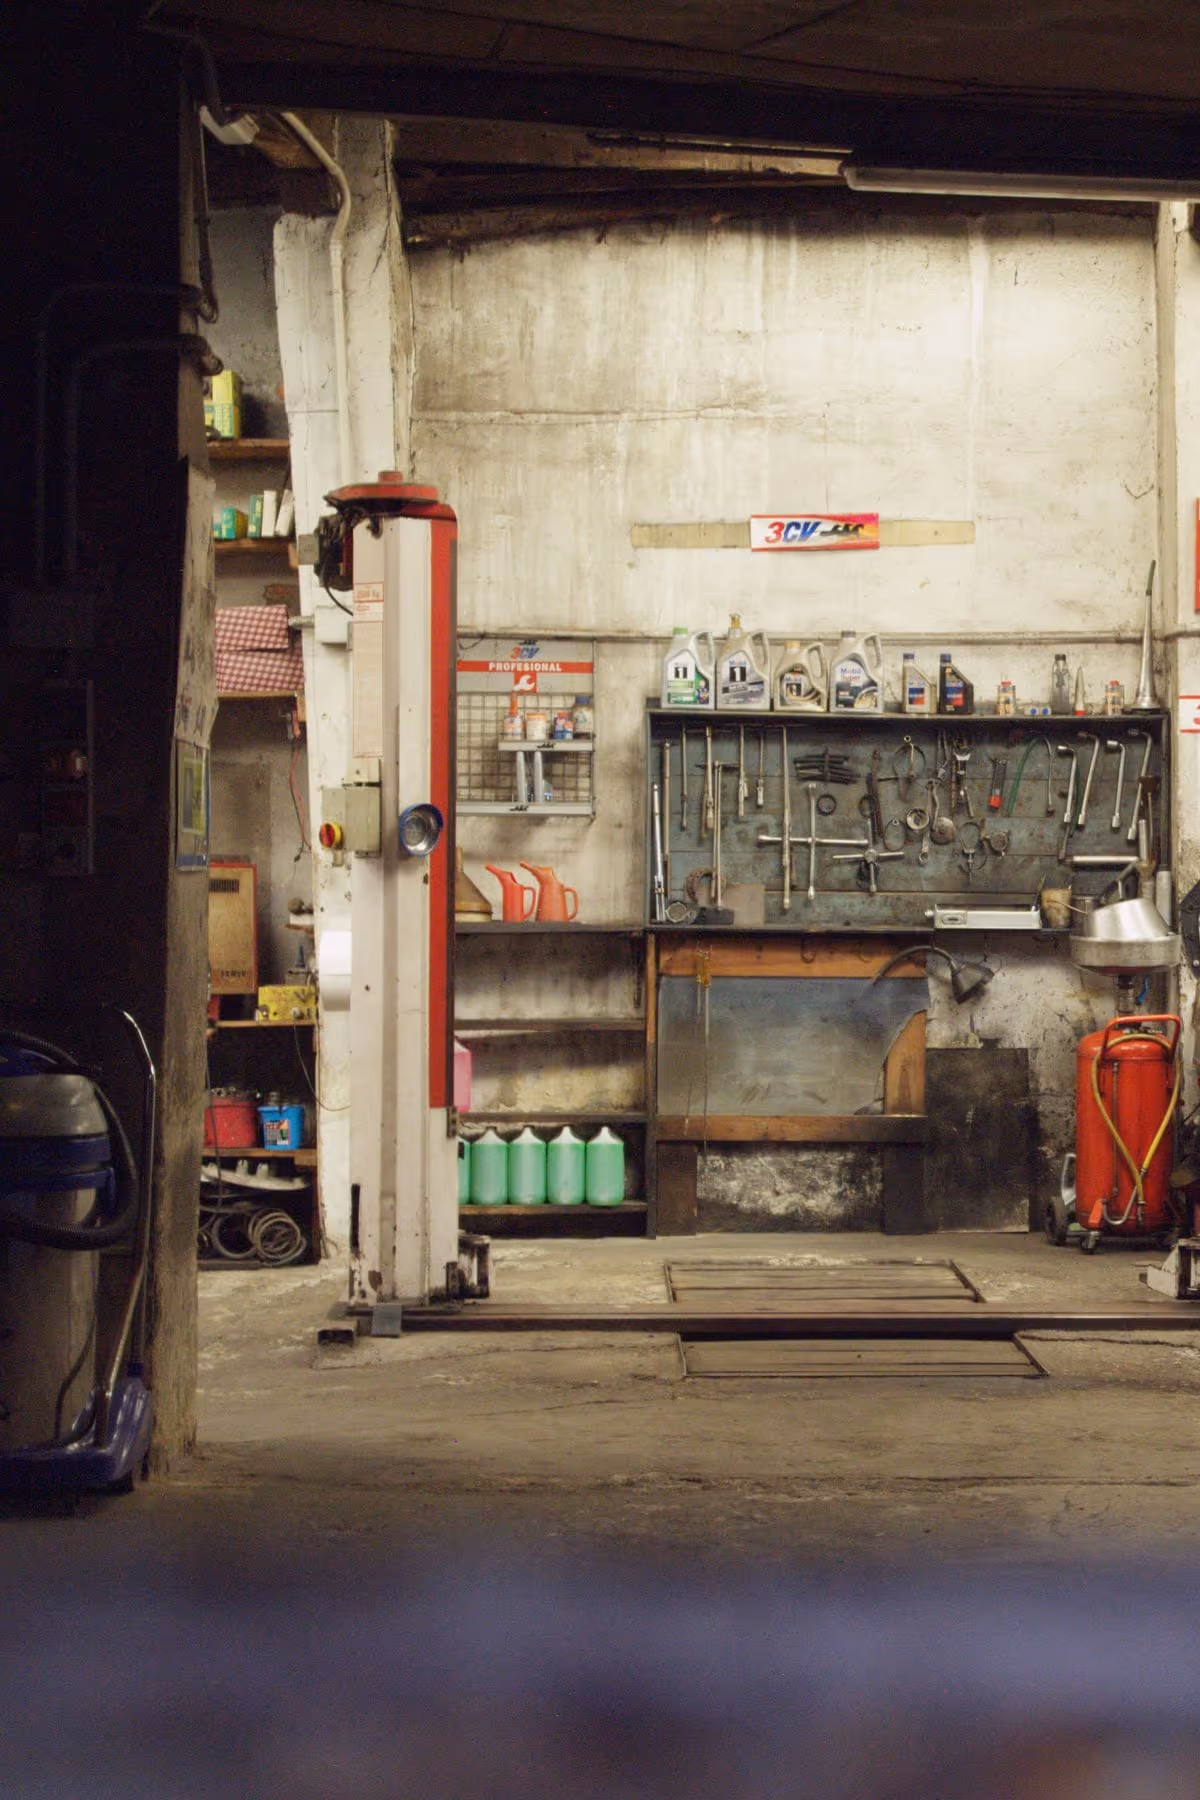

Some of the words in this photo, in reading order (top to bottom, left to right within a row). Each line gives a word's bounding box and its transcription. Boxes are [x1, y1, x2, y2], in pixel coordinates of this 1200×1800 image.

[765, 521, 822, 544] 3CV
[511, 645, 540, 659] 3CV
[488, 661, 562, 673] PROFESIONAL
